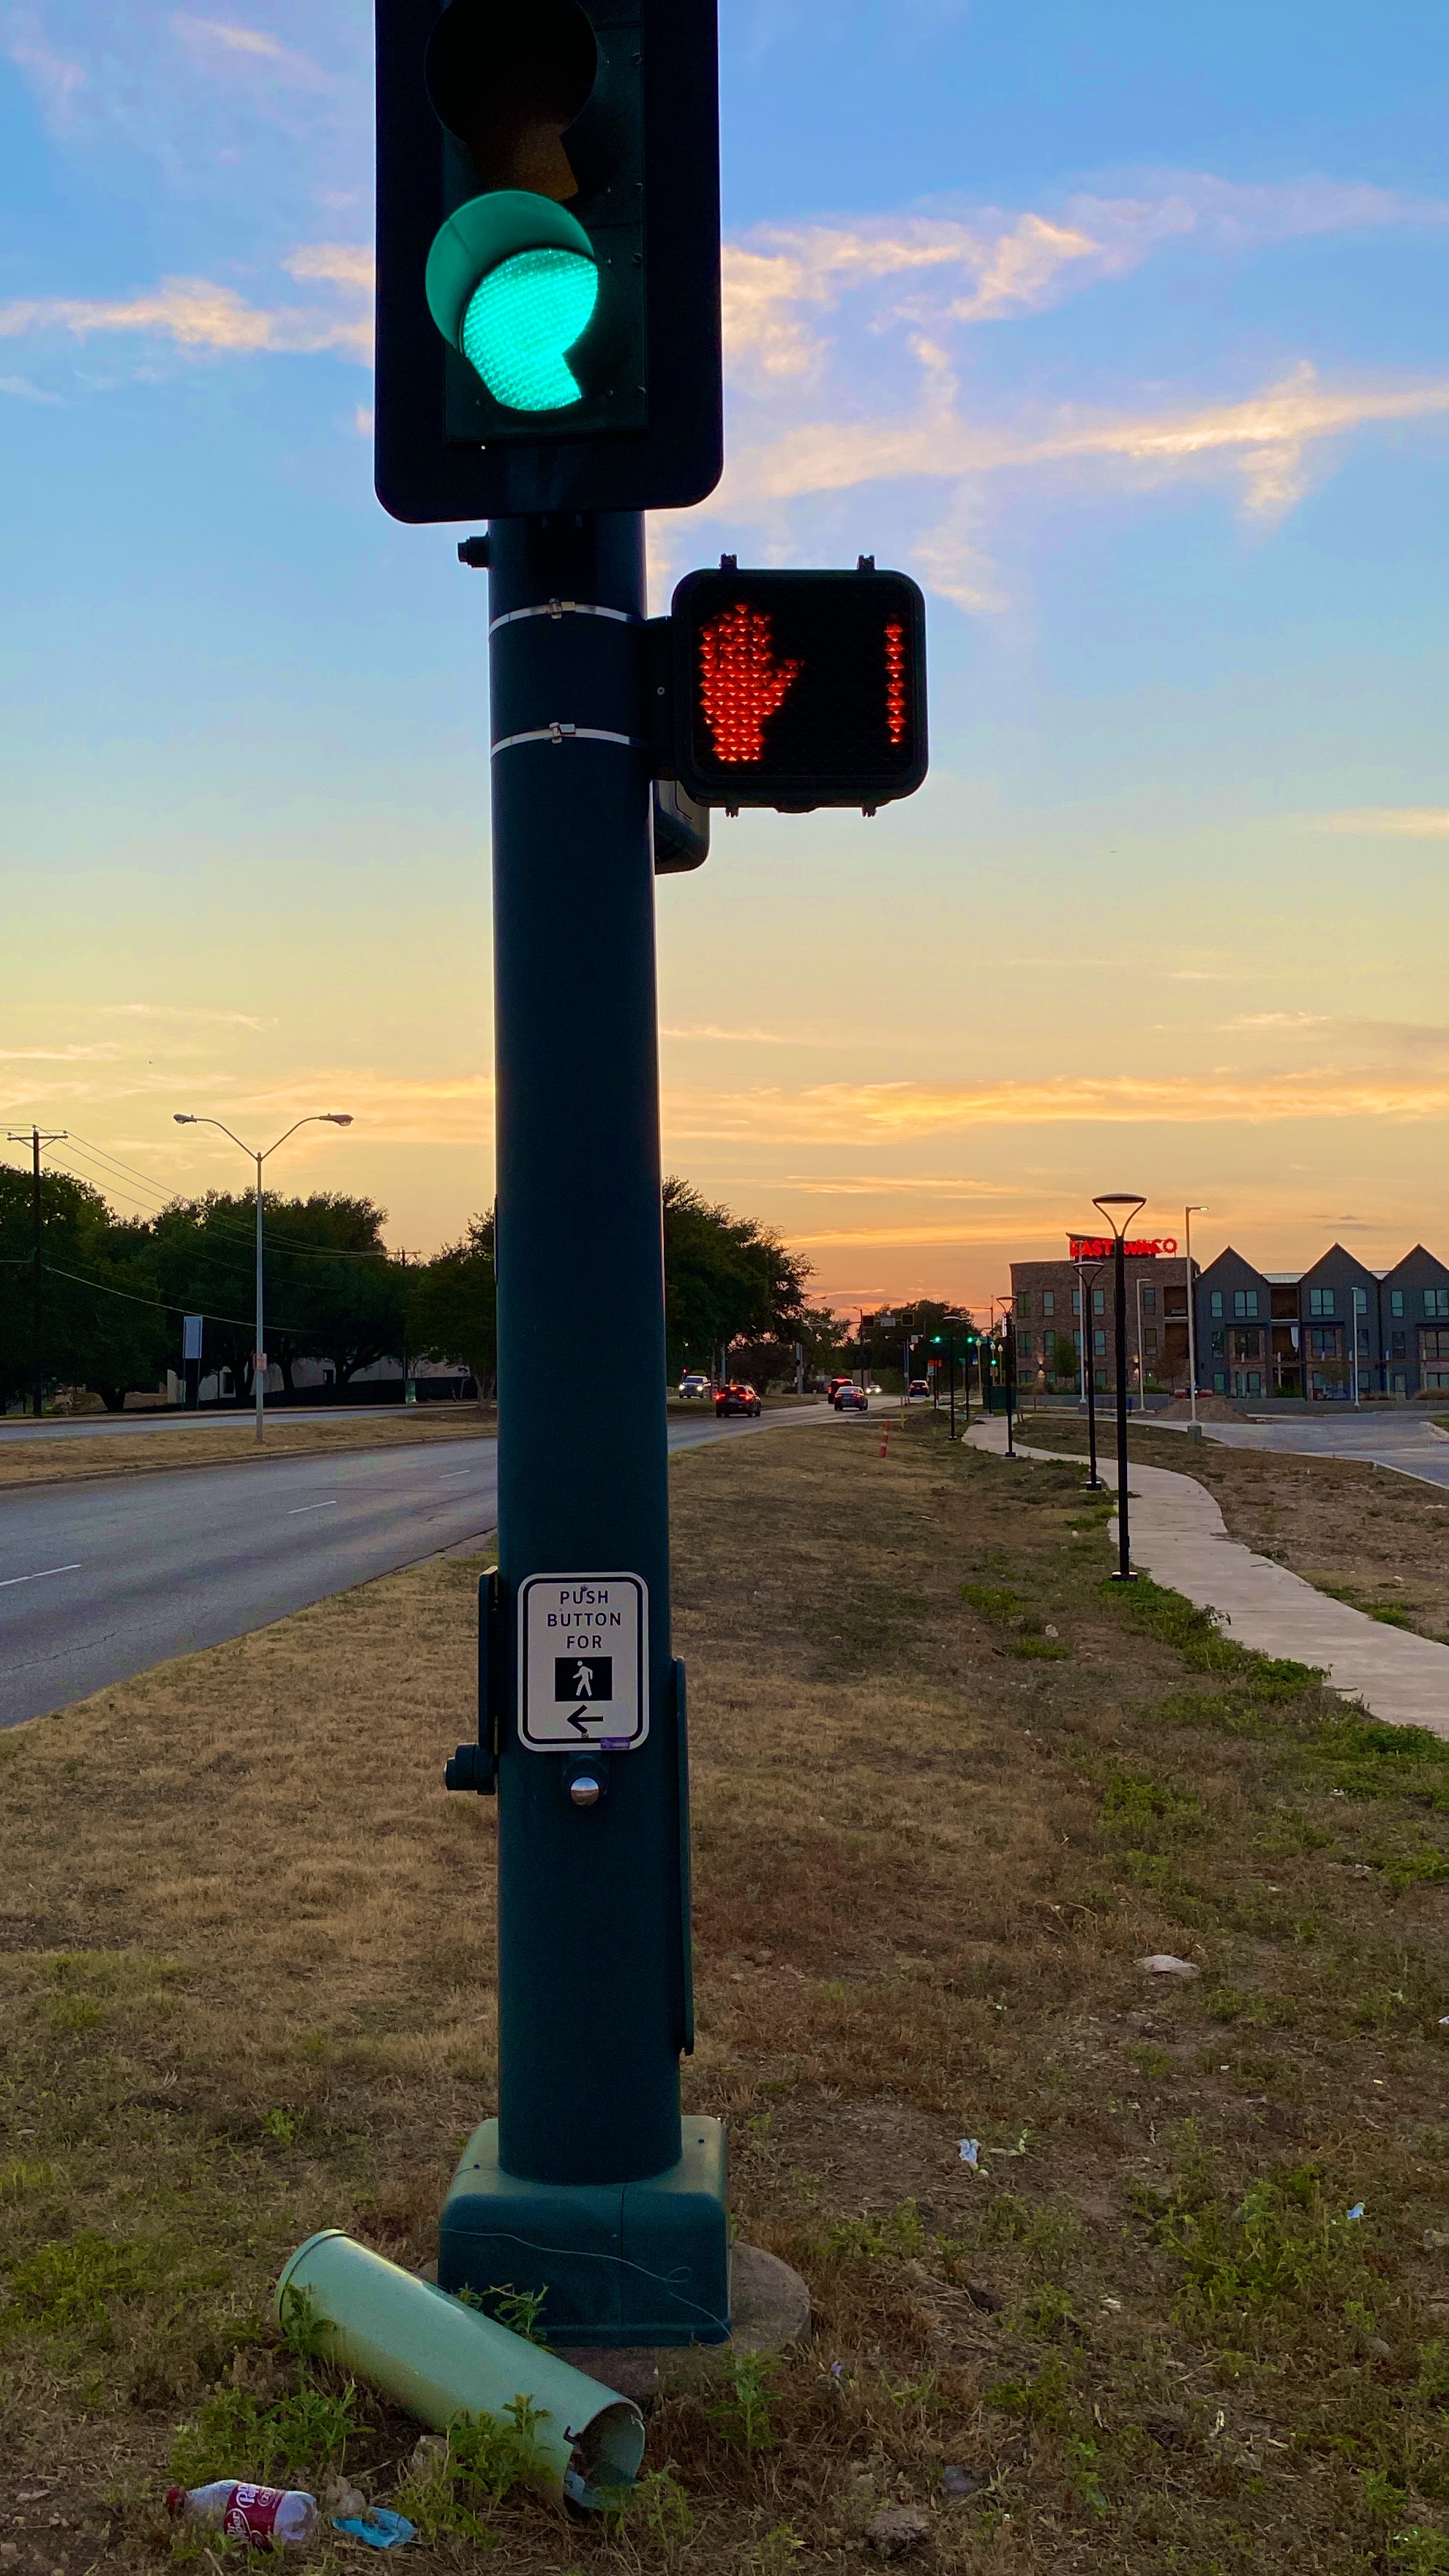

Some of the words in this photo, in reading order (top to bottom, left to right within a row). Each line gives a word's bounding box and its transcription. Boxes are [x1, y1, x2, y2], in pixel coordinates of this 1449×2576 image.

[1070, 1240, 1113, 1256] EAST
[1124, 1238, 1177, 1255] WACO
[560, 1590, 608, 1604] PUSH
[547, 1612, 621, 1627] BUTTON
[566, 1635, 602, 1649] FOR
